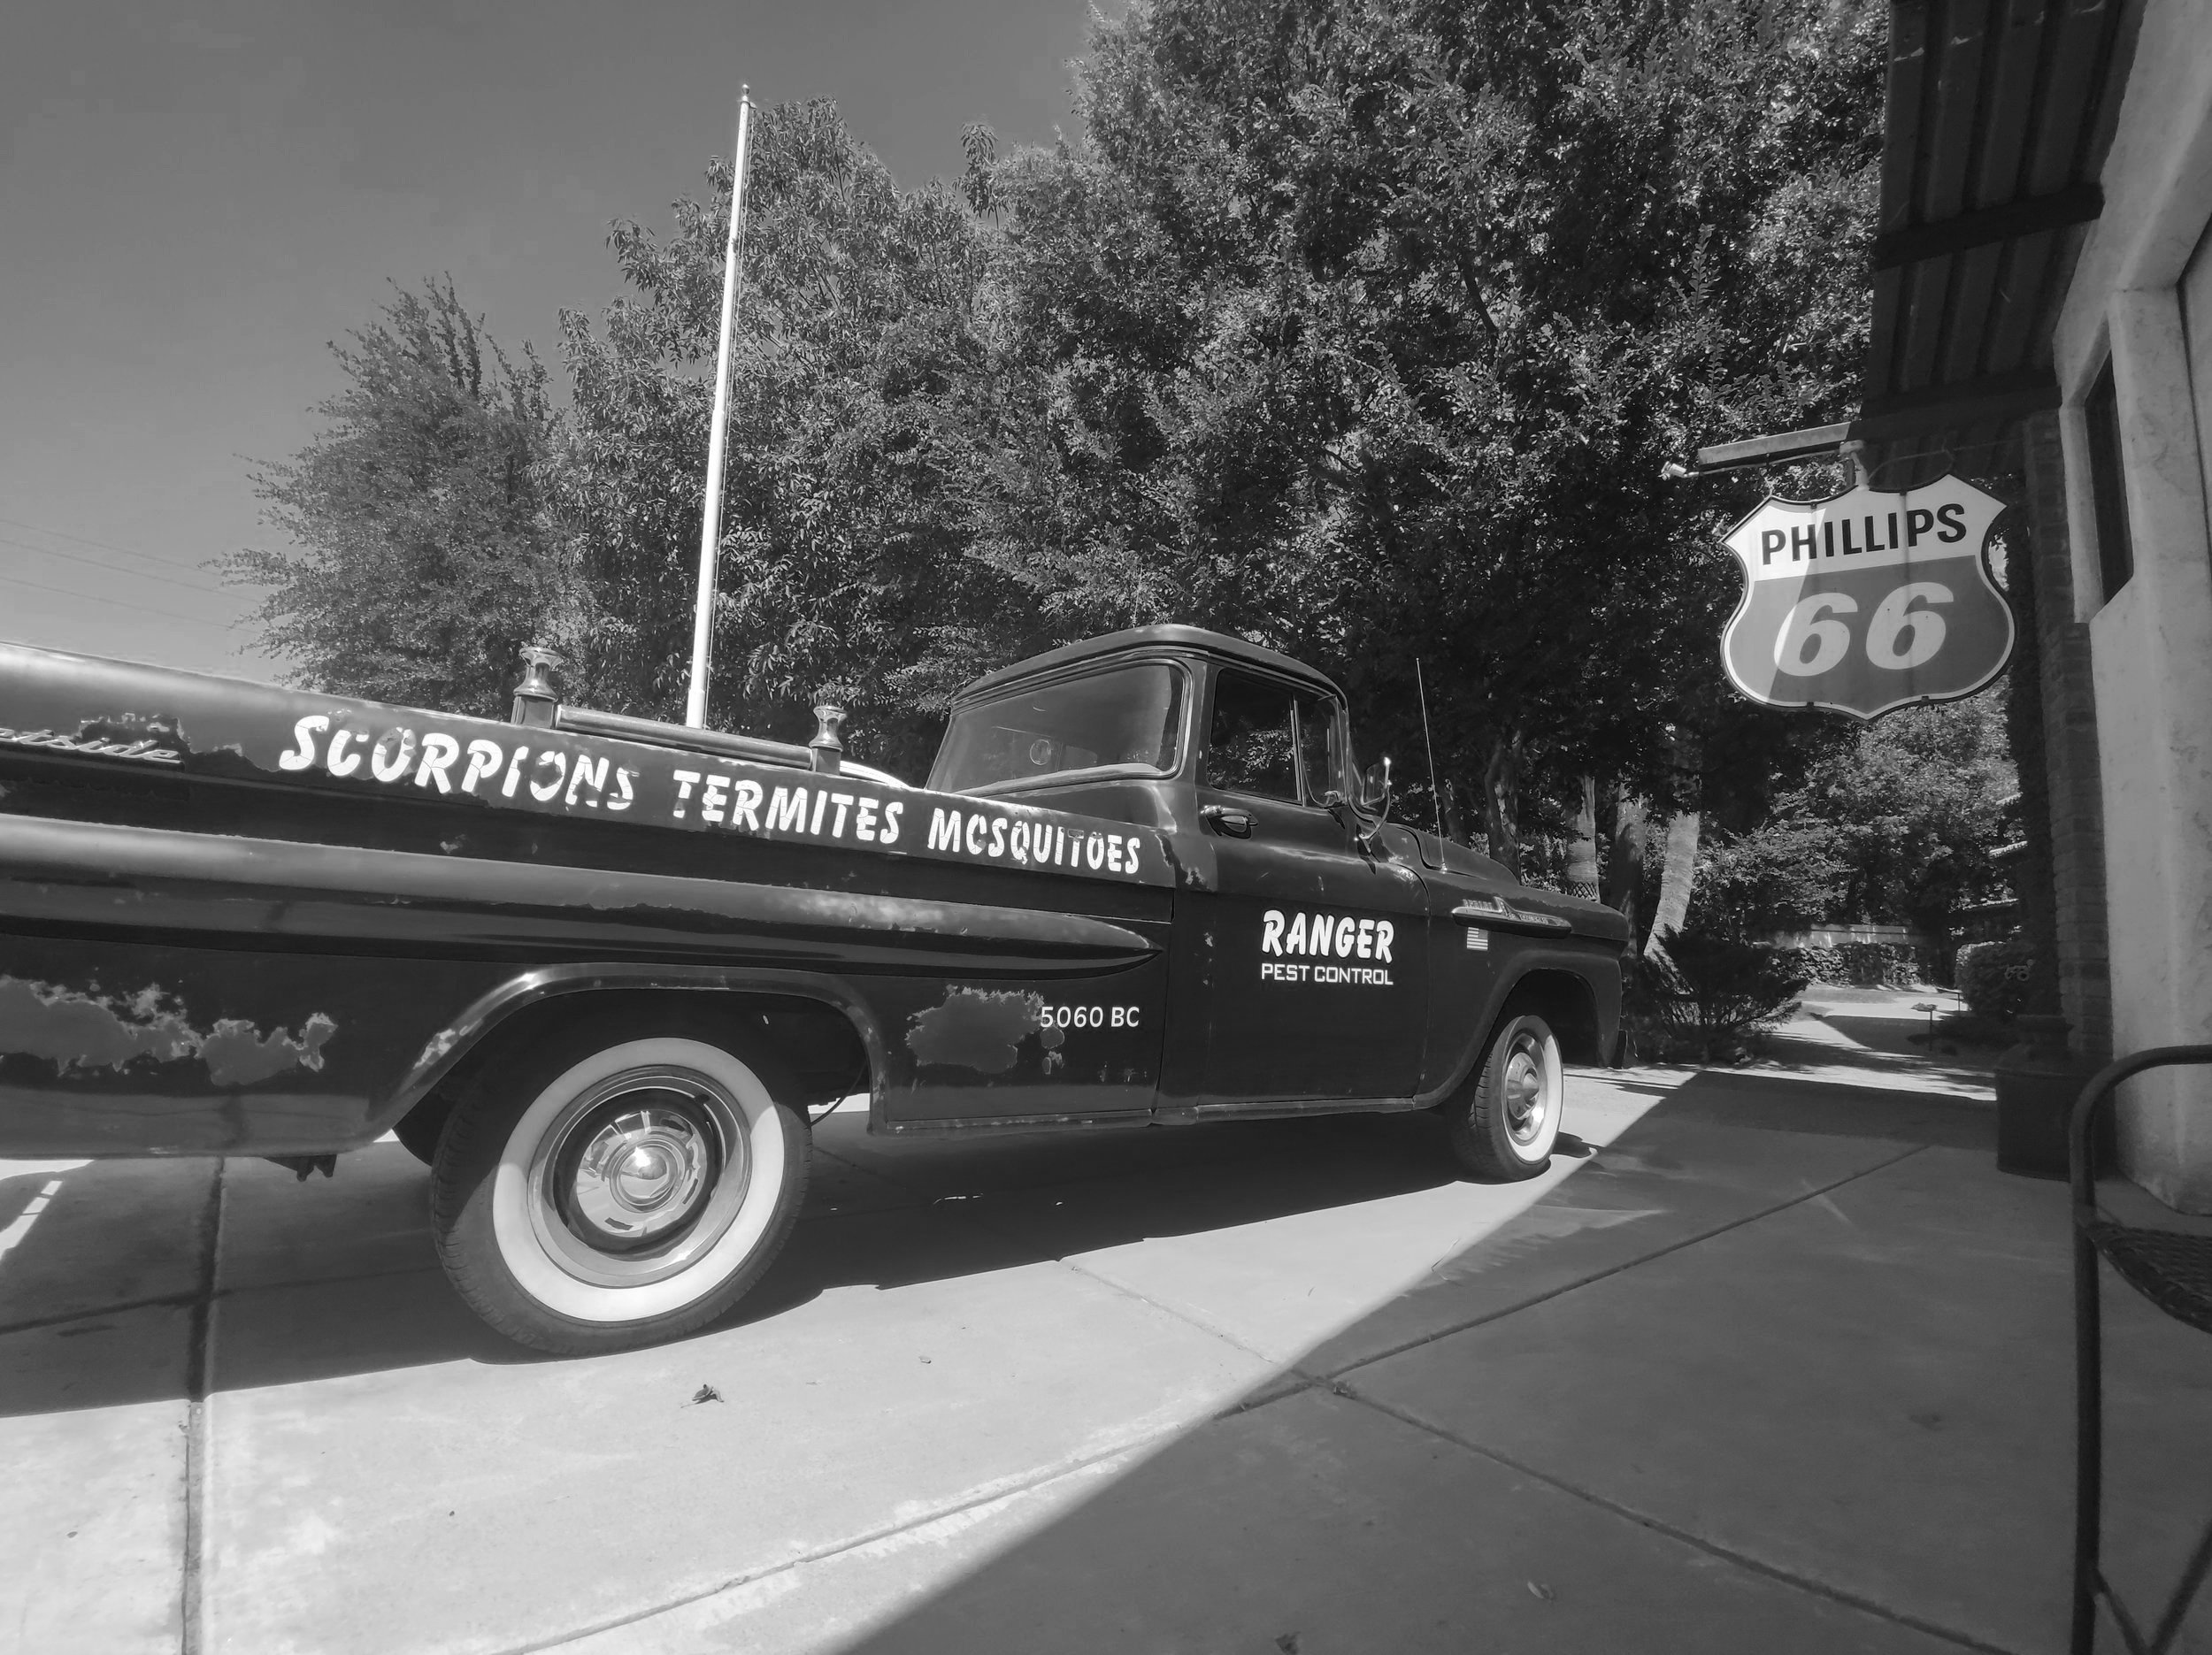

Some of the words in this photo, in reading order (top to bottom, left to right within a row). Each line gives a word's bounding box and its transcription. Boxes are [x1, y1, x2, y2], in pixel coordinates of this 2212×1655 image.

[1761, 503, 1967, 565] PHILLIPS
[1773, 582, 1955, 677] 66
[279, 715, 639, 810] SCORPIONS
[672, 769, 903, 844] TERMITES
[1262, 909, 1394, 963] RANGER
[1261, 963, 1310, 982] PEST
[1314, 966, 1394, 985] CONTROL
[1040, 1006, 1104, 1029] 5060
[1110, 1006, 1141, 1029] BC
